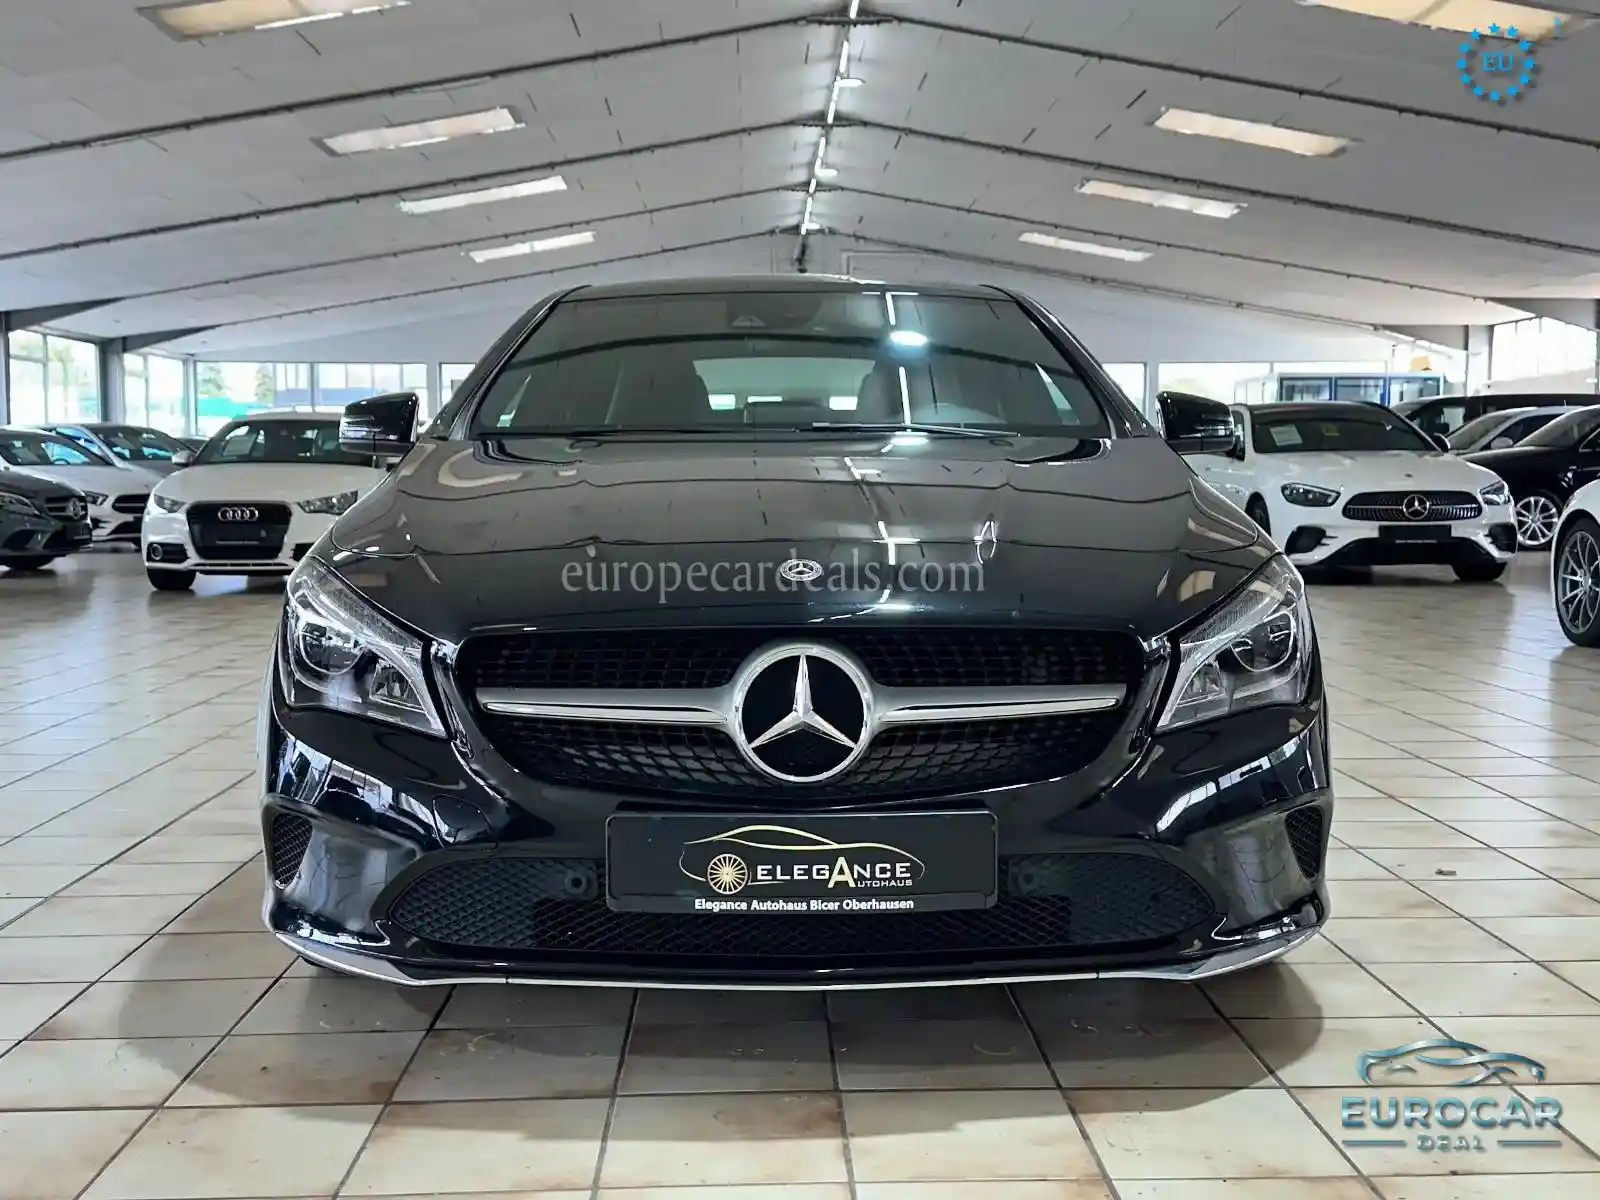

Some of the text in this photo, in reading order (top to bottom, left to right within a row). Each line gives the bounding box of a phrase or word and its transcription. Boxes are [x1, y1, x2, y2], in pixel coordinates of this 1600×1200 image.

[756, 856, 912, 888] ELEGANCE
[694, 898, 915, 913] Elegance Autohaus Bicer Oberhausen
